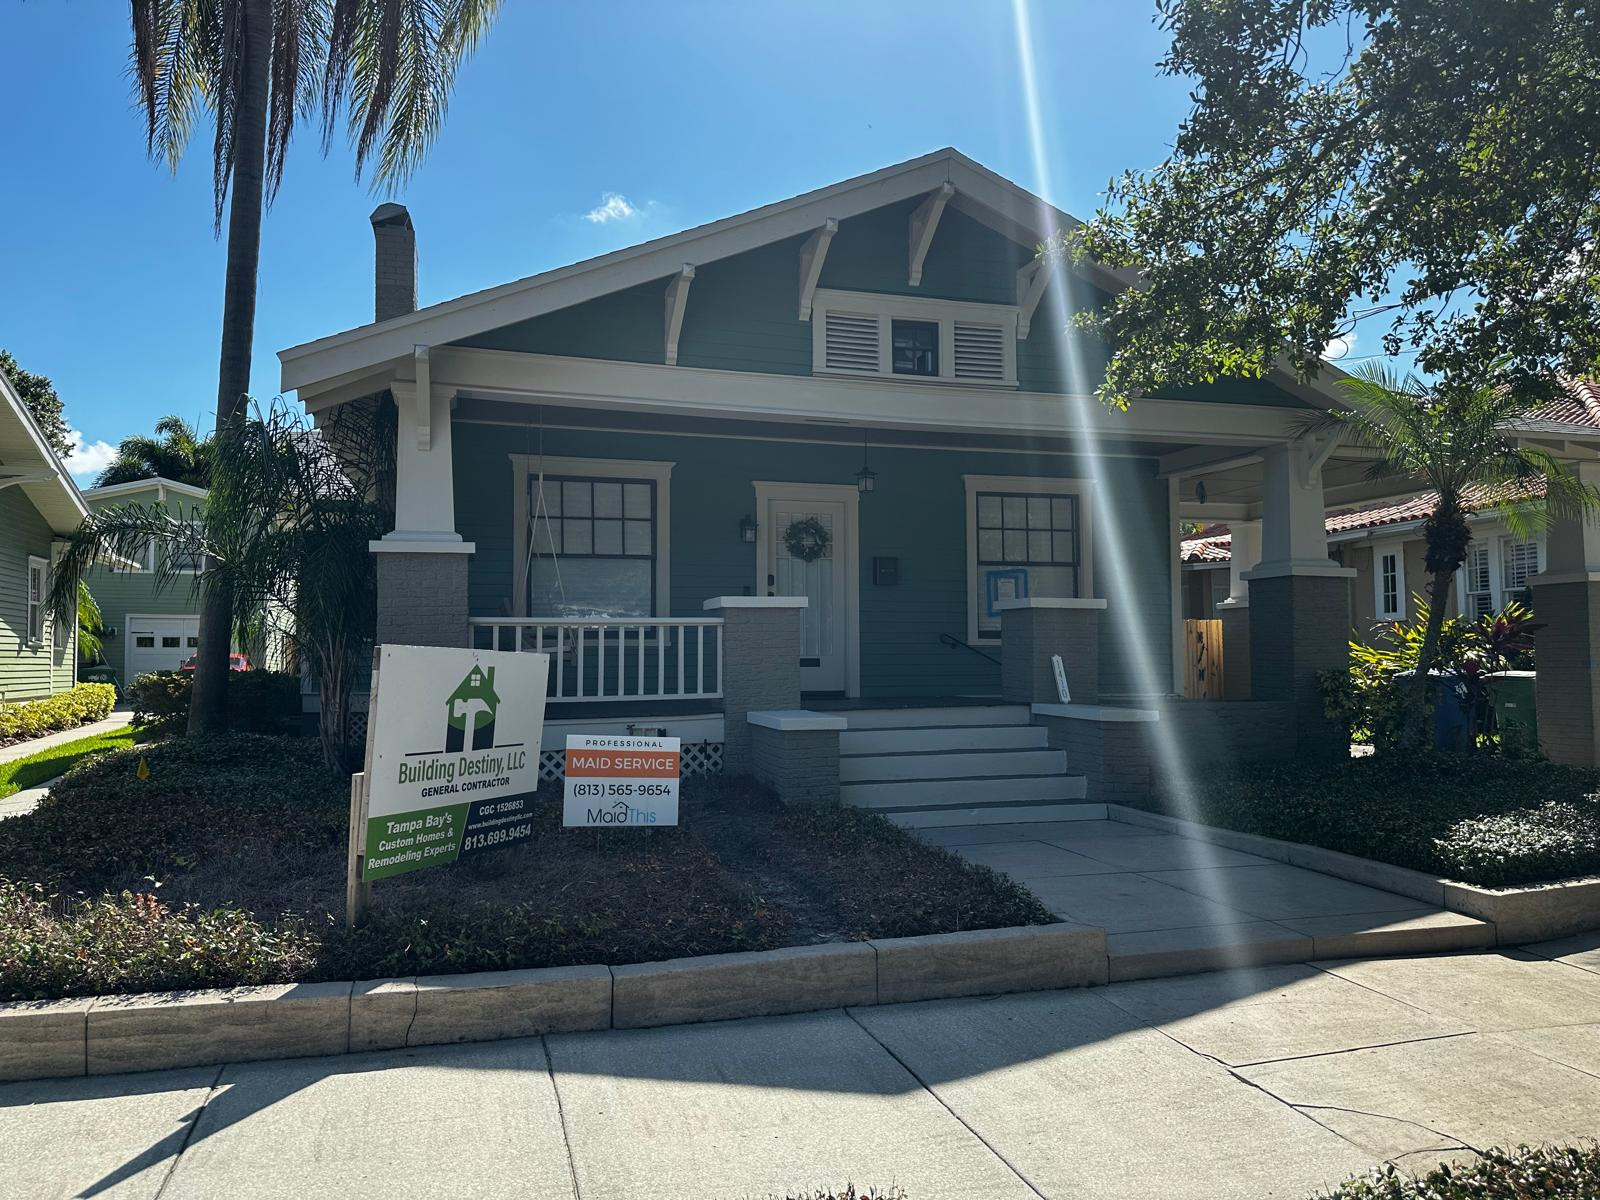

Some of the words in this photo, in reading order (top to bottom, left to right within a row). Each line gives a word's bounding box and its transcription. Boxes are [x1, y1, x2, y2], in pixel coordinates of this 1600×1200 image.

[585, 739, 663, 748] PROFESSIONAL
[398, 759, 455, 784] Building
[458, 755, 504, 778] Destiny,
[506, 751, 526, 771] LLC
[572, 757, 611, 769] MAID
[614, 758, 674, 770] SERVICE
[421, 784, 460, 798] GENERAL
[461, 776, 510, 792] CONTRACTOR
[573, 783, 606, 798] (813)
[608, 784, 671, 796] 565-9654
[479, 804, 495, 816] CGC
[386, 819, 423, 834] Tampa
[425, 812, 453, 828] Bay's
[378, 838, 414, 852] Custom
[415, 831, 445, 844] Homes
[447, 827, 454, 838] &
[464, 823, 532, 851] 813.699.9454
[367, 850, 422, 869] Remodeling
[423, 841, 457, 857] Experts
